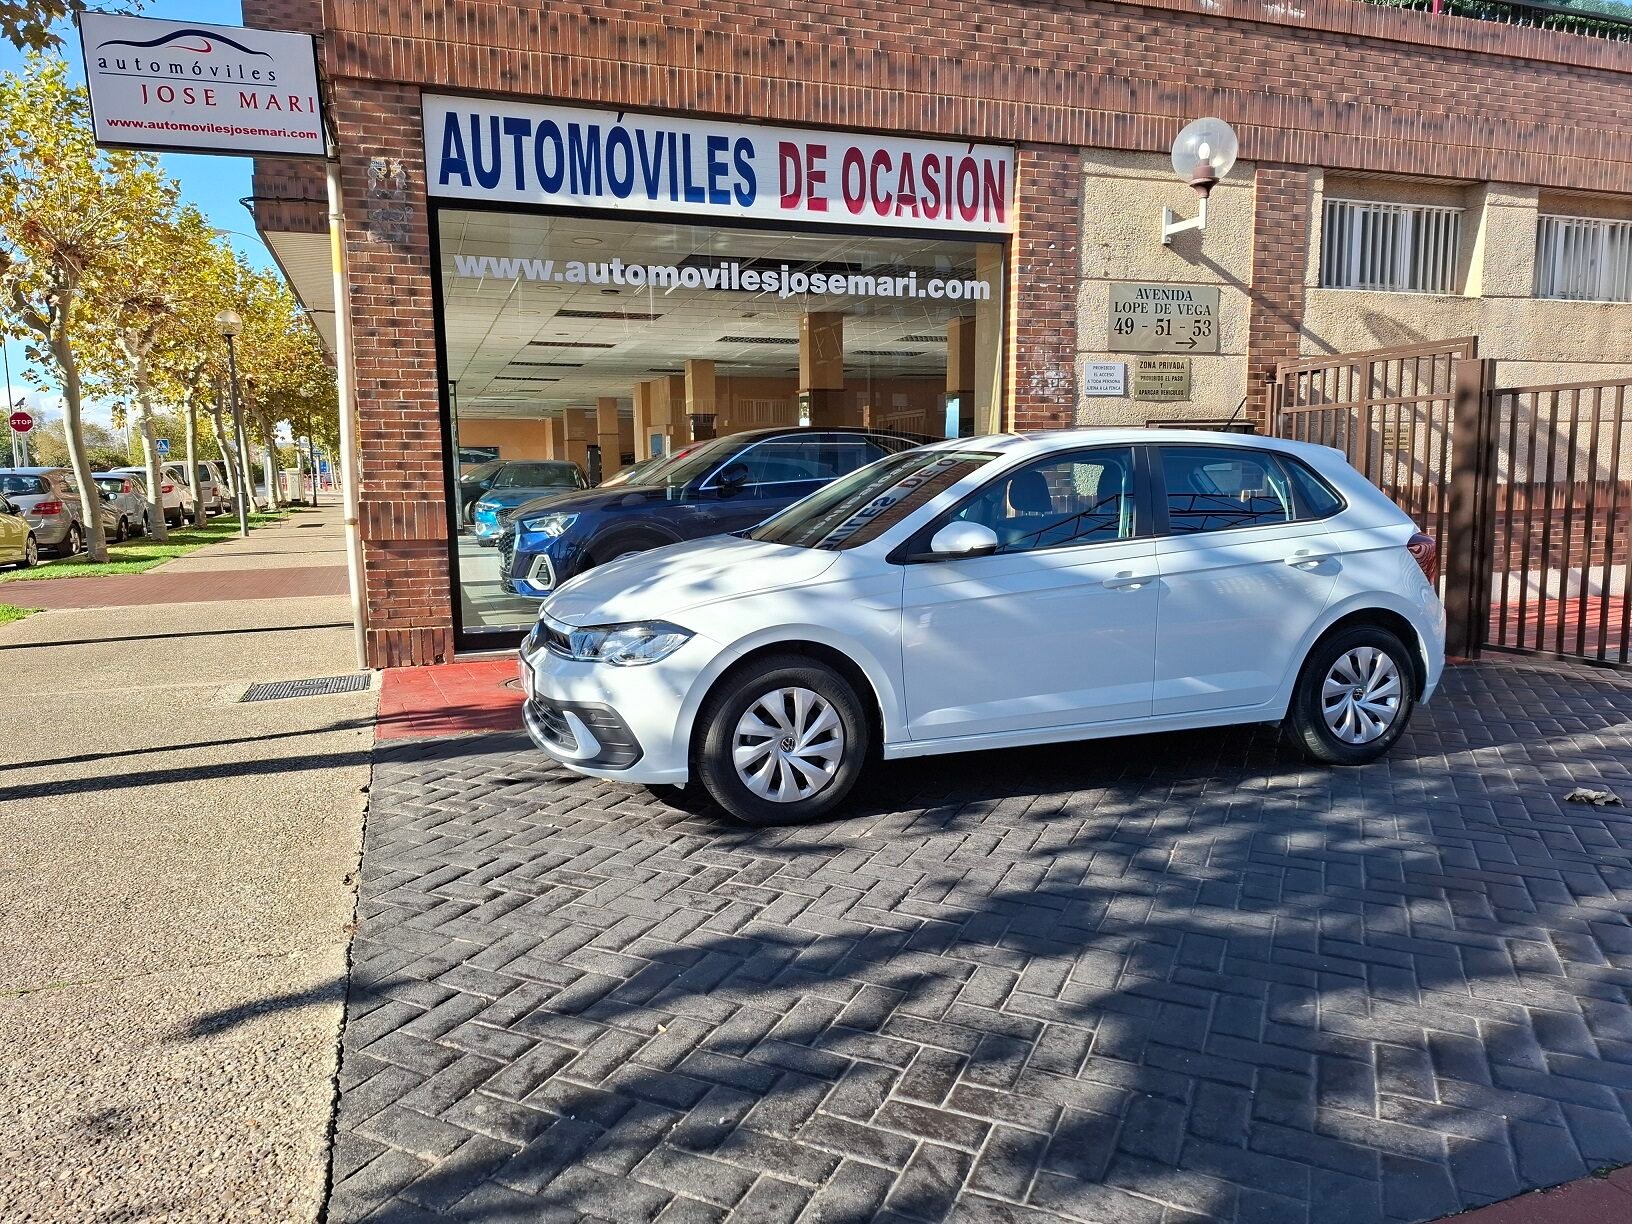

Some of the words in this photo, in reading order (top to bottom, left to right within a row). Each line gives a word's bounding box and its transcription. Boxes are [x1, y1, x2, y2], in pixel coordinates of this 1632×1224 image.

[98, 56, 276, 81] automóviles
[141, 84, 217, 106] JOSE
[239, 91, 315, 113] MARI
[106, 117, 318, 139] www.automovilesjosemari.com
[439, 111, 757, 208] AUTOMÓVILES
[778, 141, 828, 211] DE
[841, 143, 1005, 223] OCASIÓN
[454, 255, 990, 300] www.automovilesjosemari.com
[1135, 288, 1193, 301] AVENIDA
[1114, 302, 1149, 314] LOPE
[1154, 303, 1172, 315] DE
[1177, 304, 1211, 316] VEGA
[1114, 317, 1134, 335] 49
[1155, 318, 1172, 336] 51
[1192, 319, 1211, 337] 53
[1139, 361, 1156, 369] ZONA
[1159, 362, 1185, 370] PRIVADA
